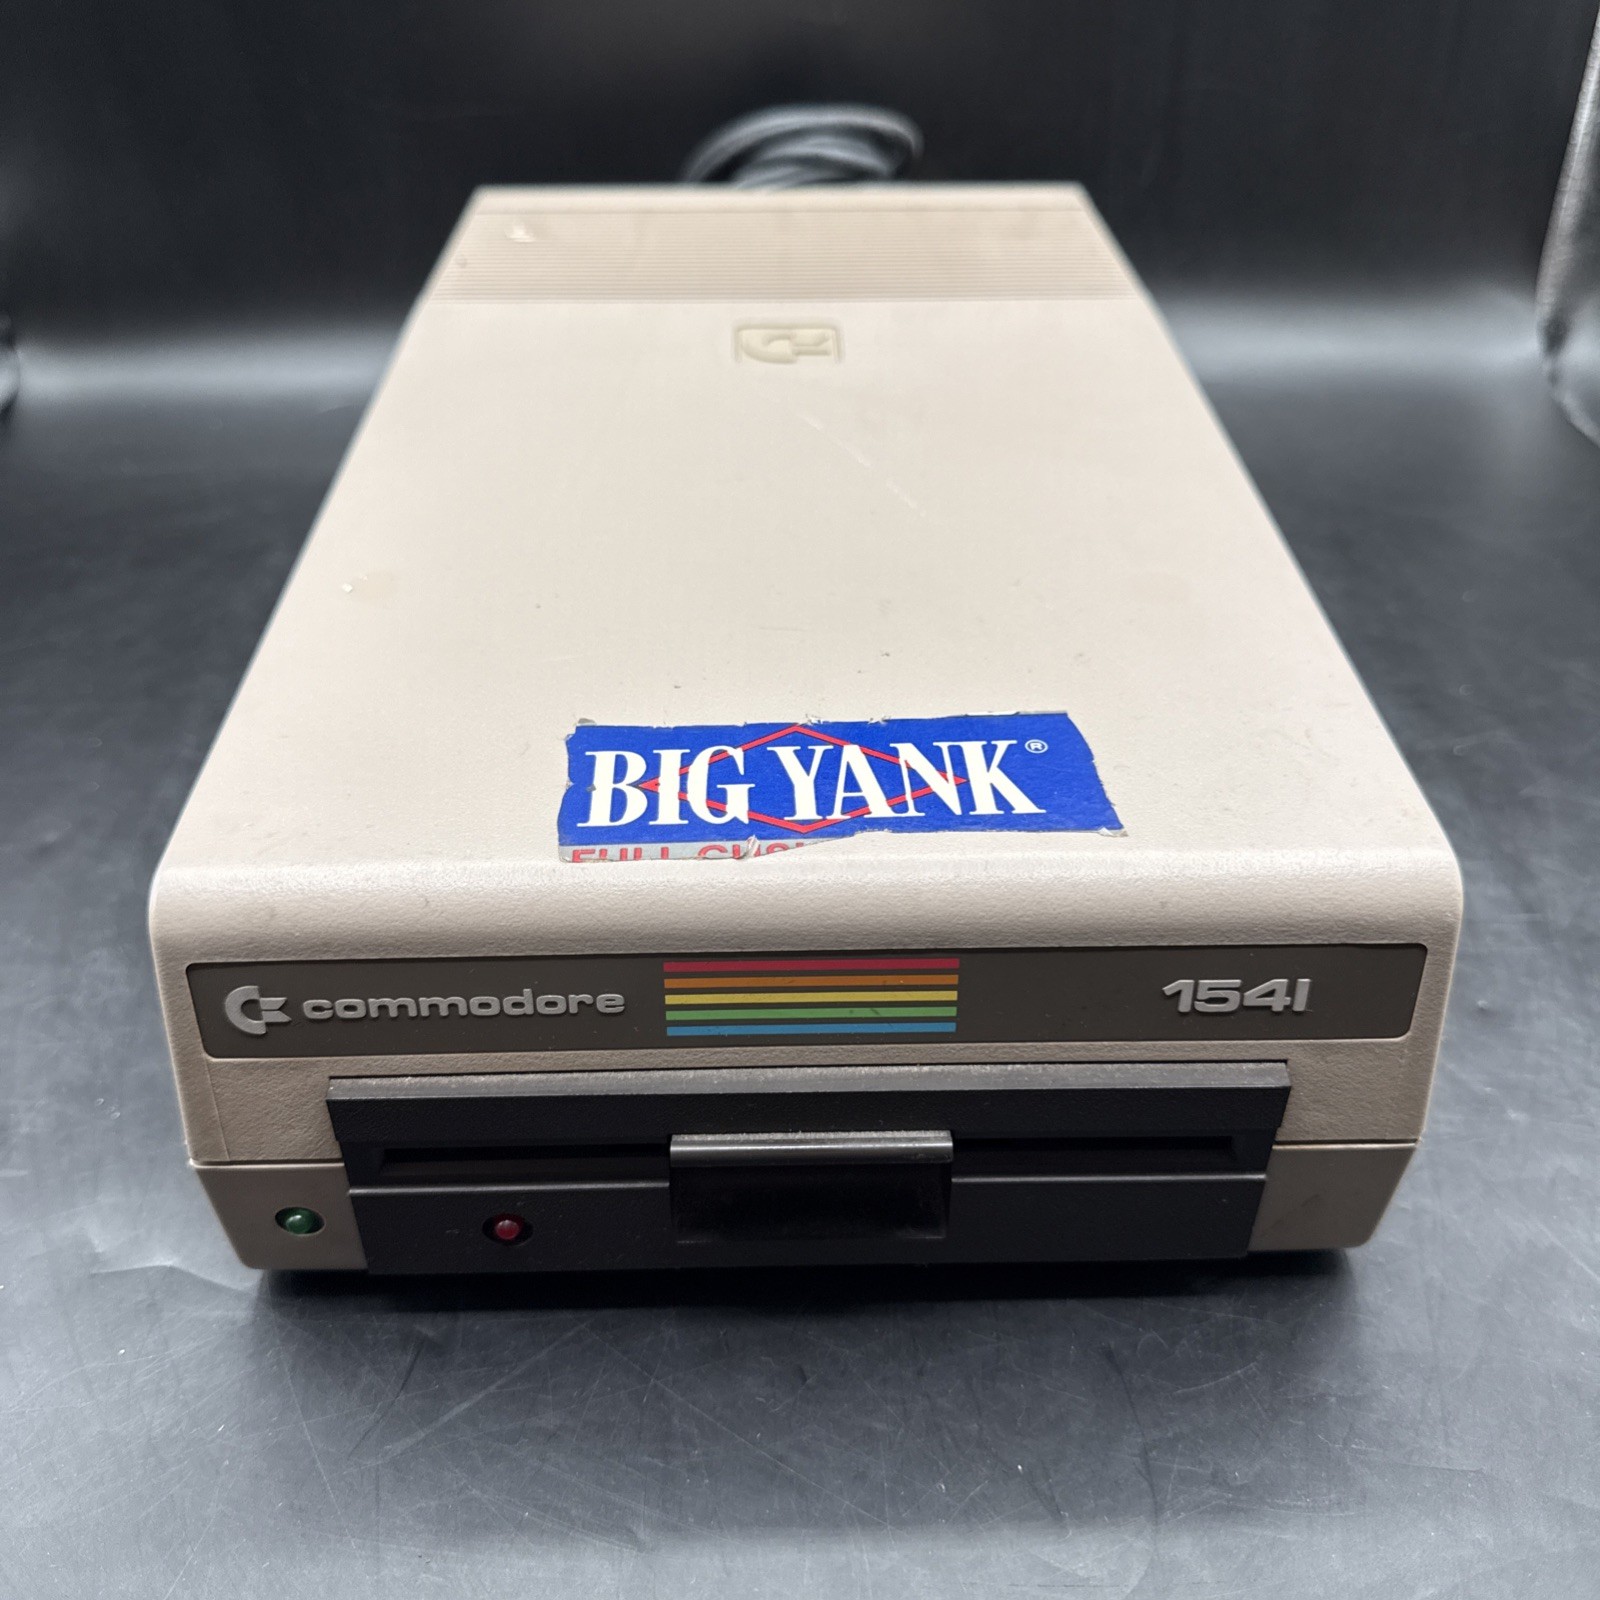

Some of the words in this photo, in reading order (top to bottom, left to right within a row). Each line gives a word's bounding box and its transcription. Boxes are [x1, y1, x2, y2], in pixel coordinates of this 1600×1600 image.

[577, 745, 756, 828] BIG
[767, 739, 1047, 820] YANK
[303, 988, 626, 1020] commodore
[1162, 978, 1312, 1013] 1541
